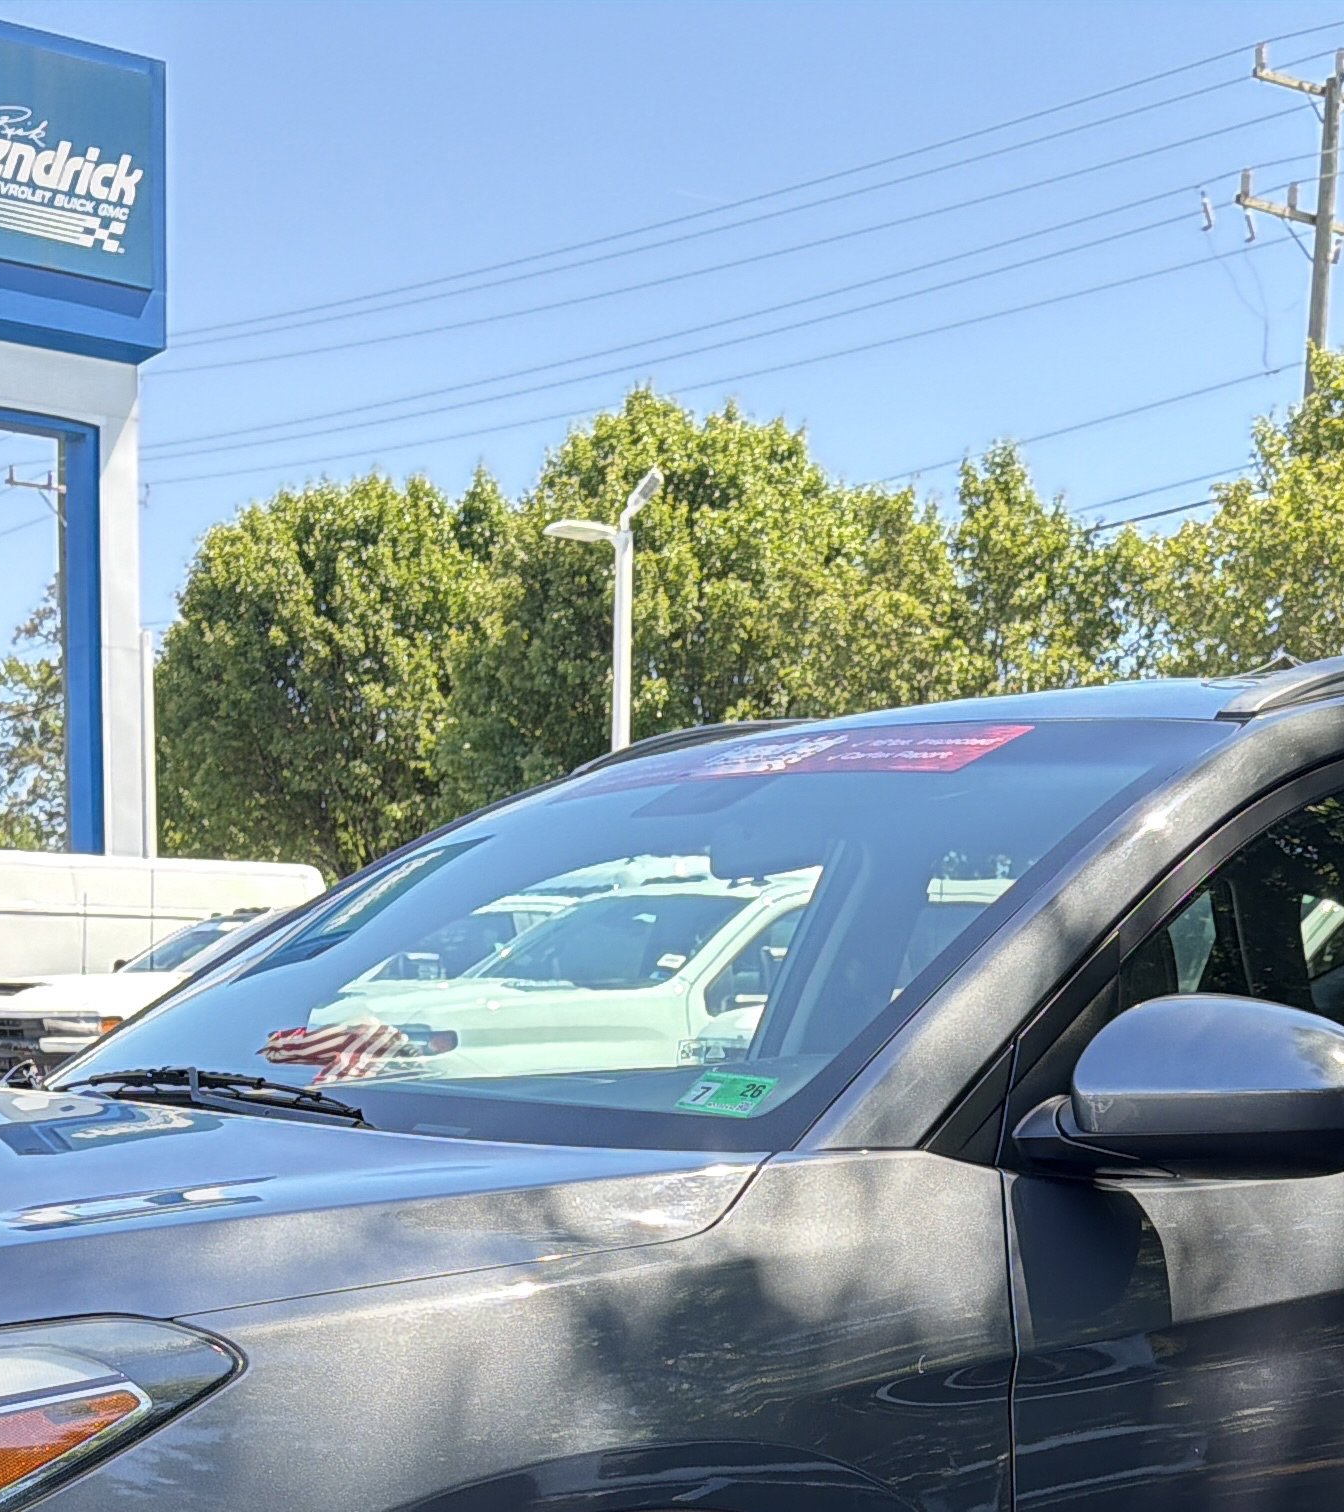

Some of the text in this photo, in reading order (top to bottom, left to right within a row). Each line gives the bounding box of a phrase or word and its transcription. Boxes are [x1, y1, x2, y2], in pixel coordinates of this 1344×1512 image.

[53, 193, 96, 214] BUICK
[97, 202, 130, 221] GMC
[691, 1083, 767, 1102] 7 26
